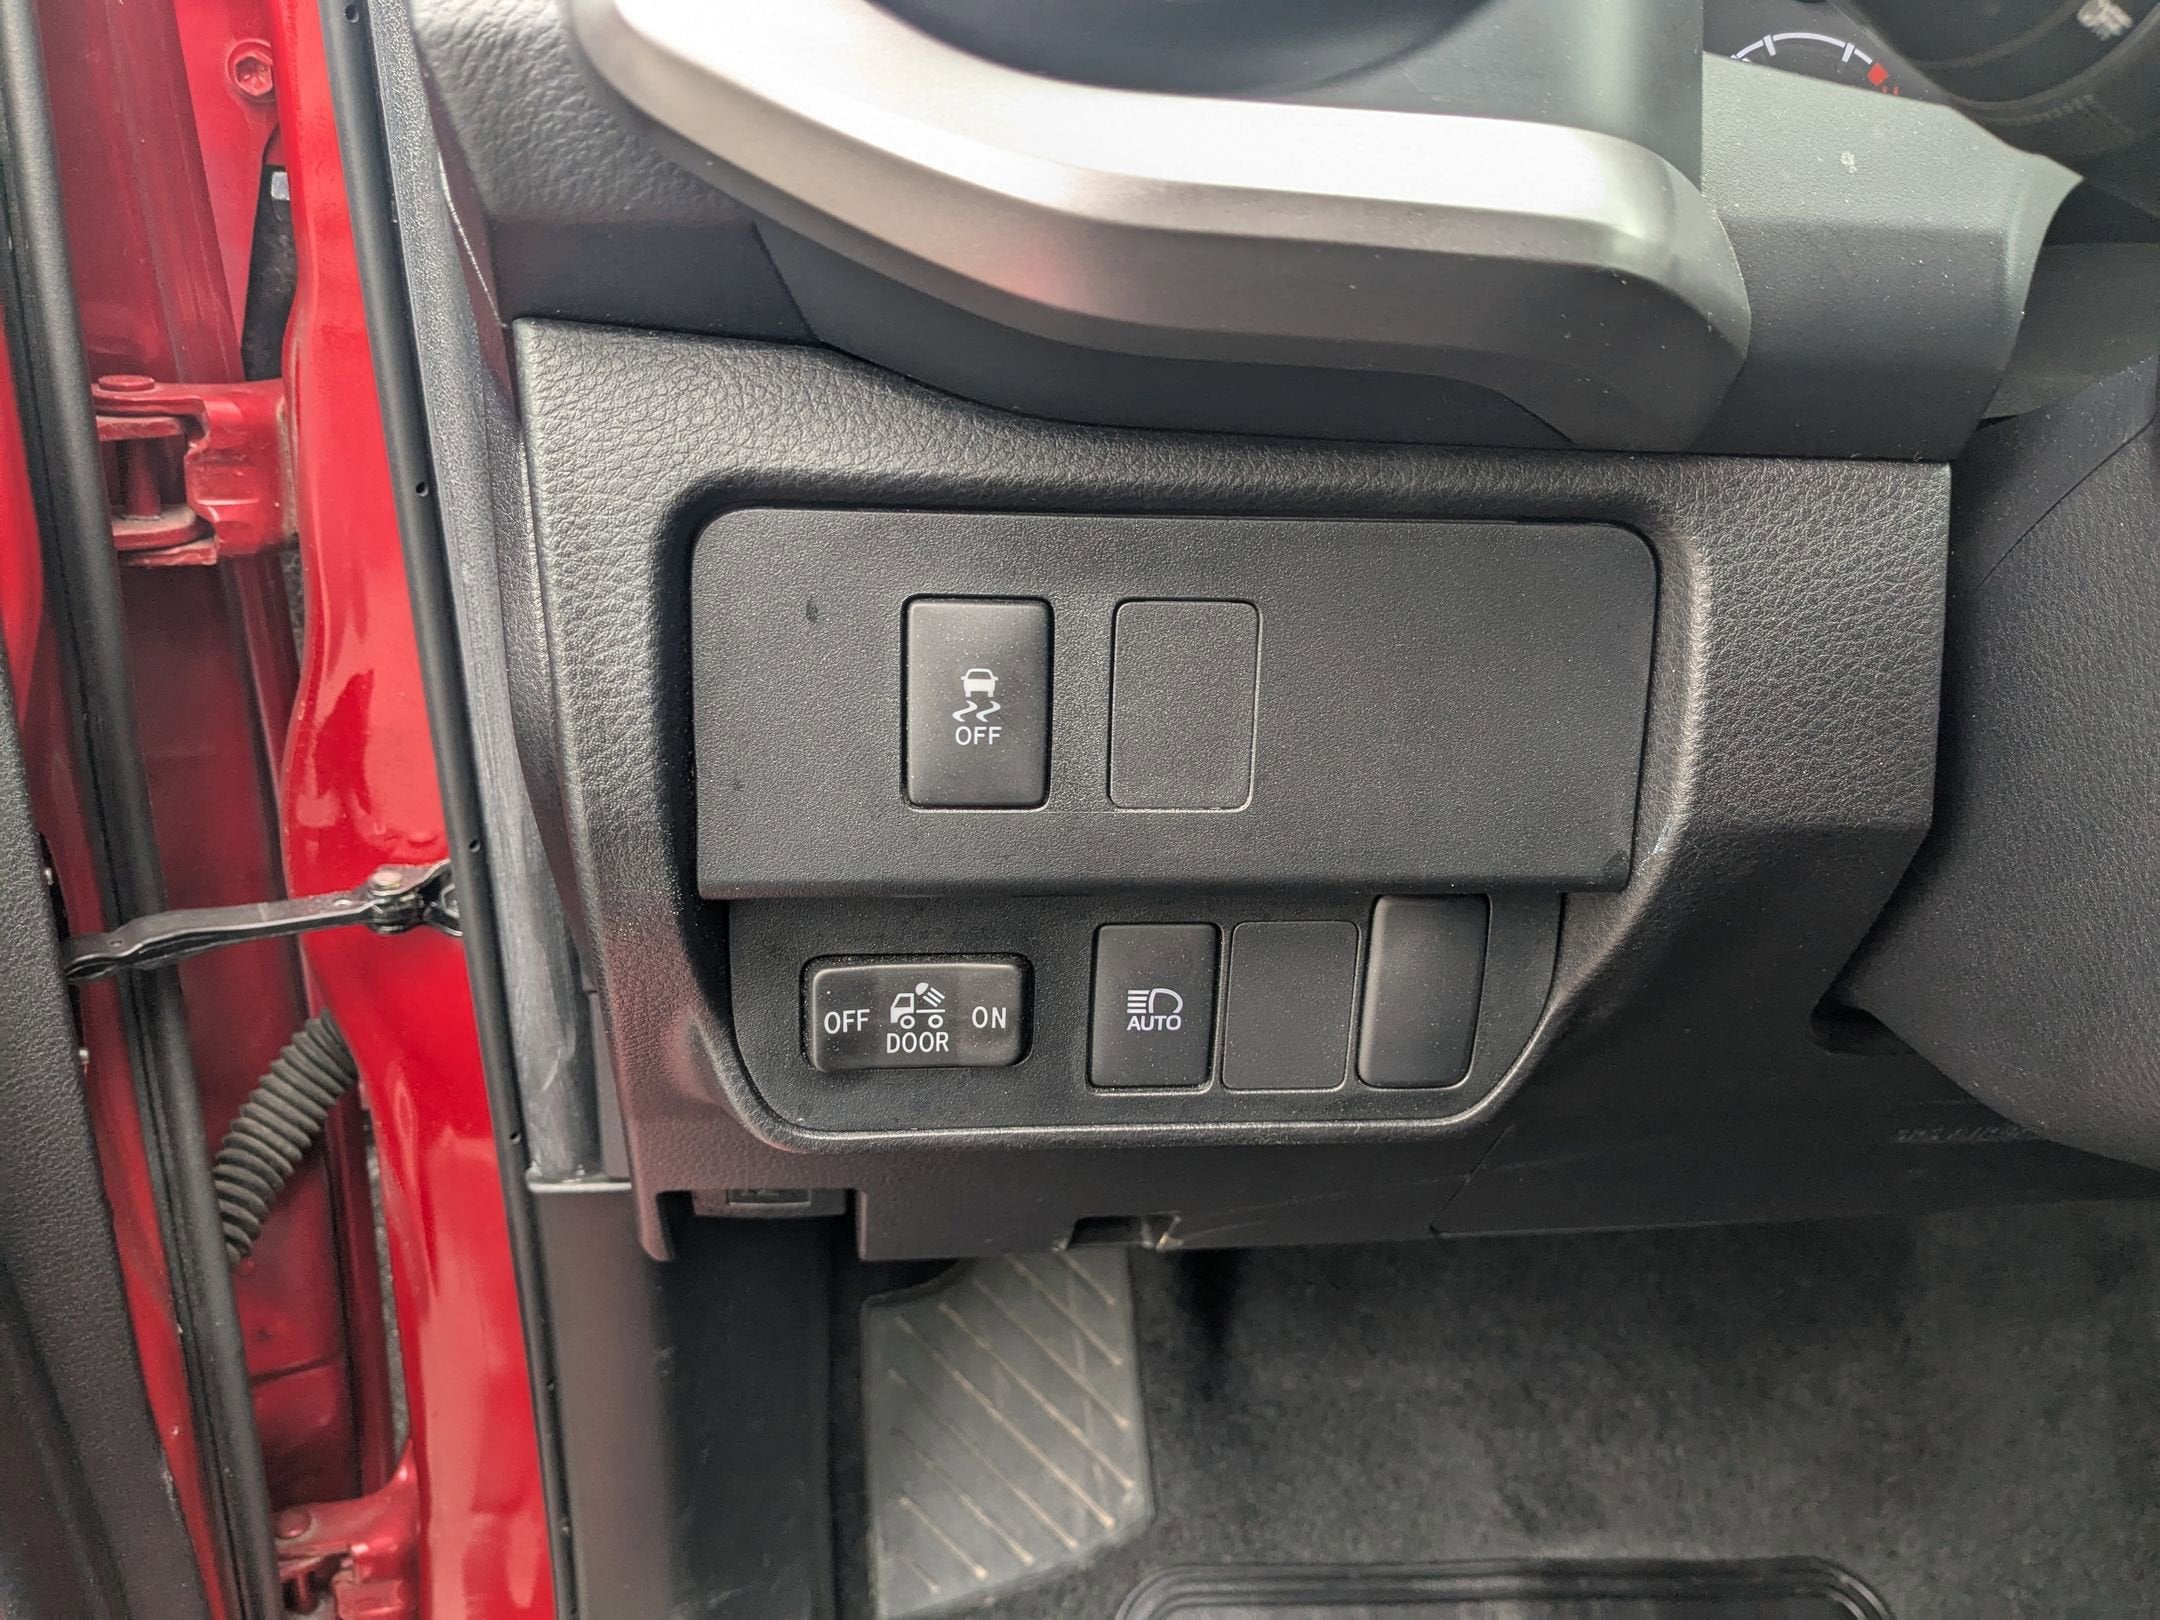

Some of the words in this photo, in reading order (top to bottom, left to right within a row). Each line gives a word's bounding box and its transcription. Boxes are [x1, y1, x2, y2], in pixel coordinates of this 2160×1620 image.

[955, 726, 1002, 745] OFF
[824, 1009, 870, 1034] OFF
[972, 1006, 1006, 1029] ON
[1126, 1014, 1182, 1031] AUTO
[886, 1031, 949, 1053] DOOR
